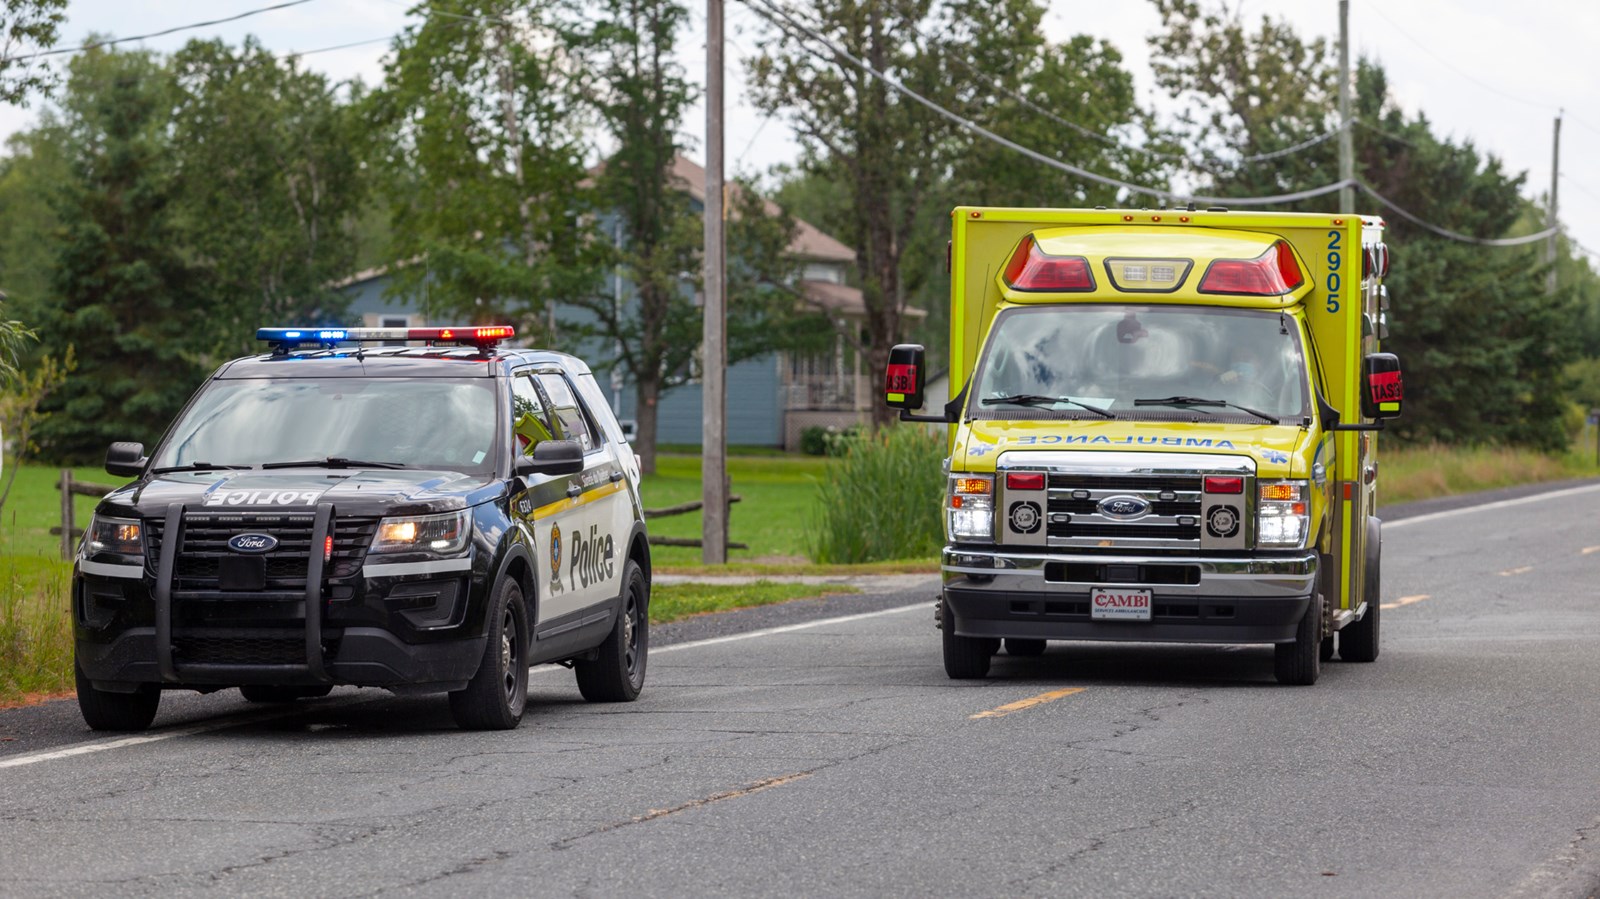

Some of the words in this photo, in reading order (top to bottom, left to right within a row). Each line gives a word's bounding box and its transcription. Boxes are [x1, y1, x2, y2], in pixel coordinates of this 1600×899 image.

[1326, 230, 1341, 313] 2905
[1111, 501, 1136, 514] Ford
[237, 537, 265, 548] Ford
[570, 524, 613, 591] Police
[1095, 594, 1149, 608] CAMBI
